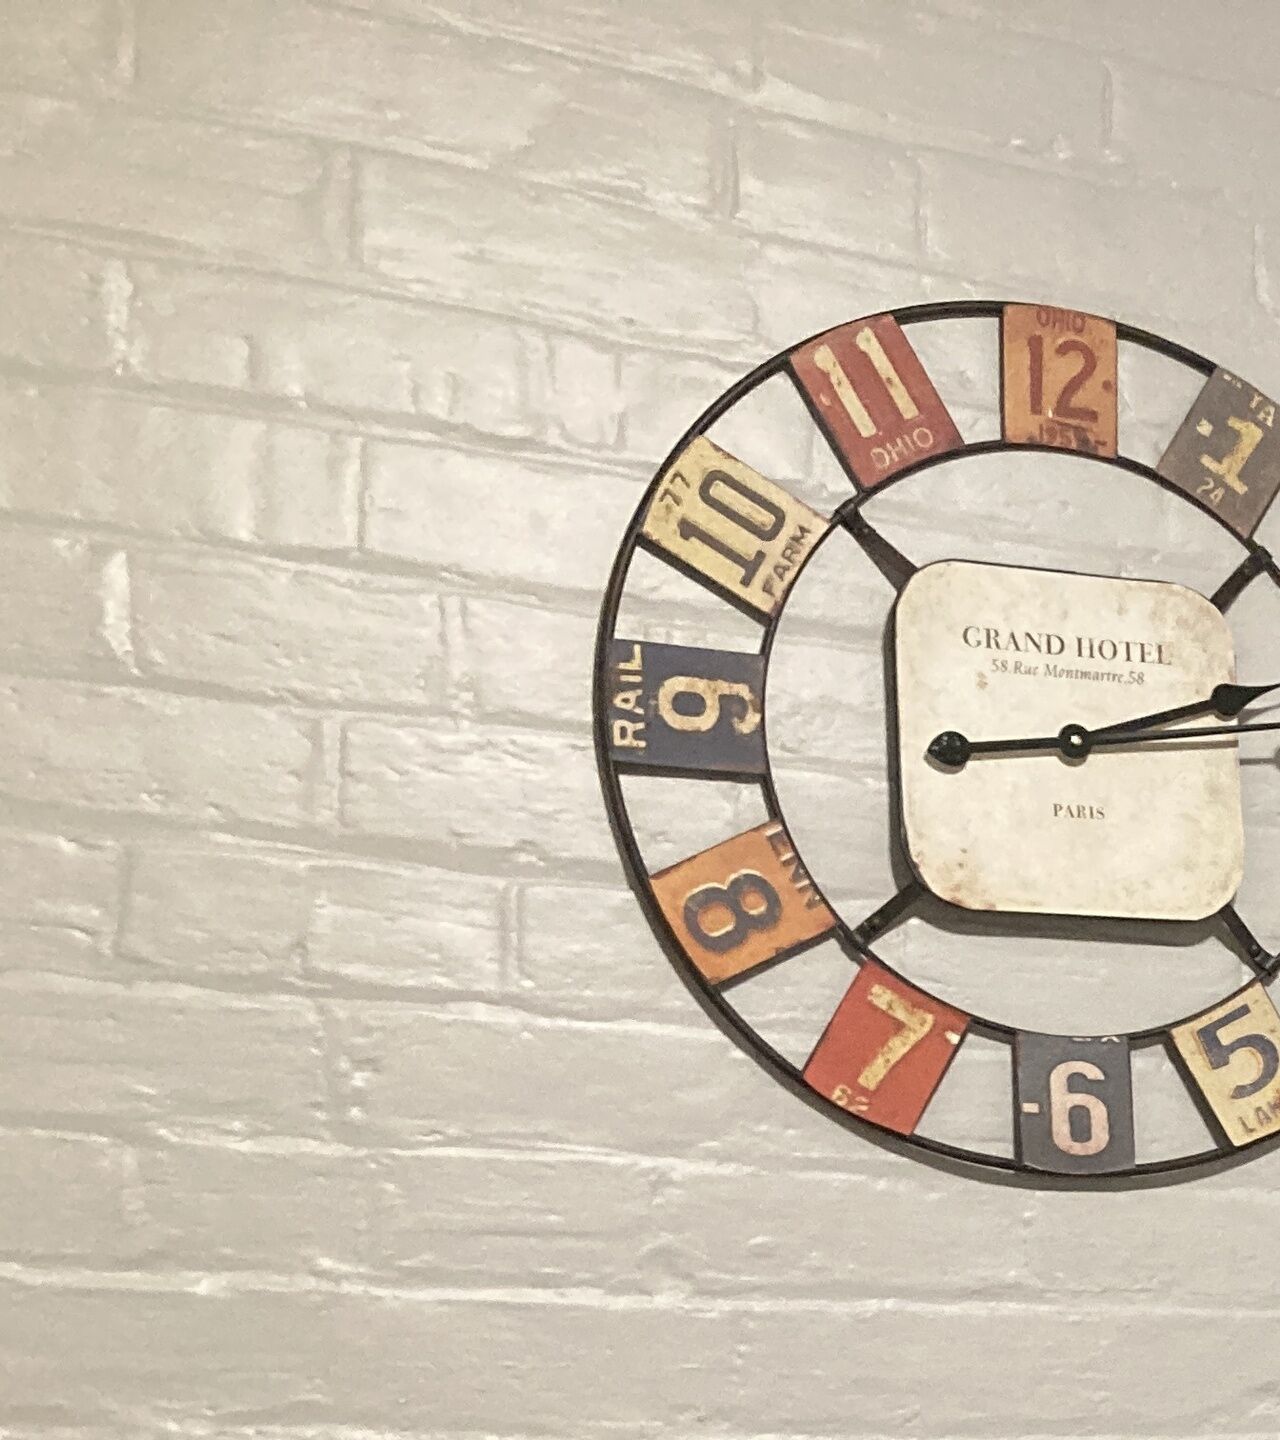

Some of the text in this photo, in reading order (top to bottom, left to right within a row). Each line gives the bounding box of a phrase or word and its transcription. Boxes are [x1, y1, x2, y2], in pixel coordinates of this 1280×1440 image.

[813, 326, 919, 438] 11
[1027, 334, 1098, 422] 12
[870, 427, 933, 469] OHIO
[677, 469, 786, 588] 10
[762, 524, 812, 597] FARM
[962, 625, 1172, 665] GRAND HOTEL
[613, 644, 647, 748] RAIL
[658, 676, 761, 735] 9
[1053, 803, 1106, 821] PARIS
[684, 869, 782, 954] 8
[856, 983, 936, 1091] 7
[1197, 1003, 1280, 1100] 5
